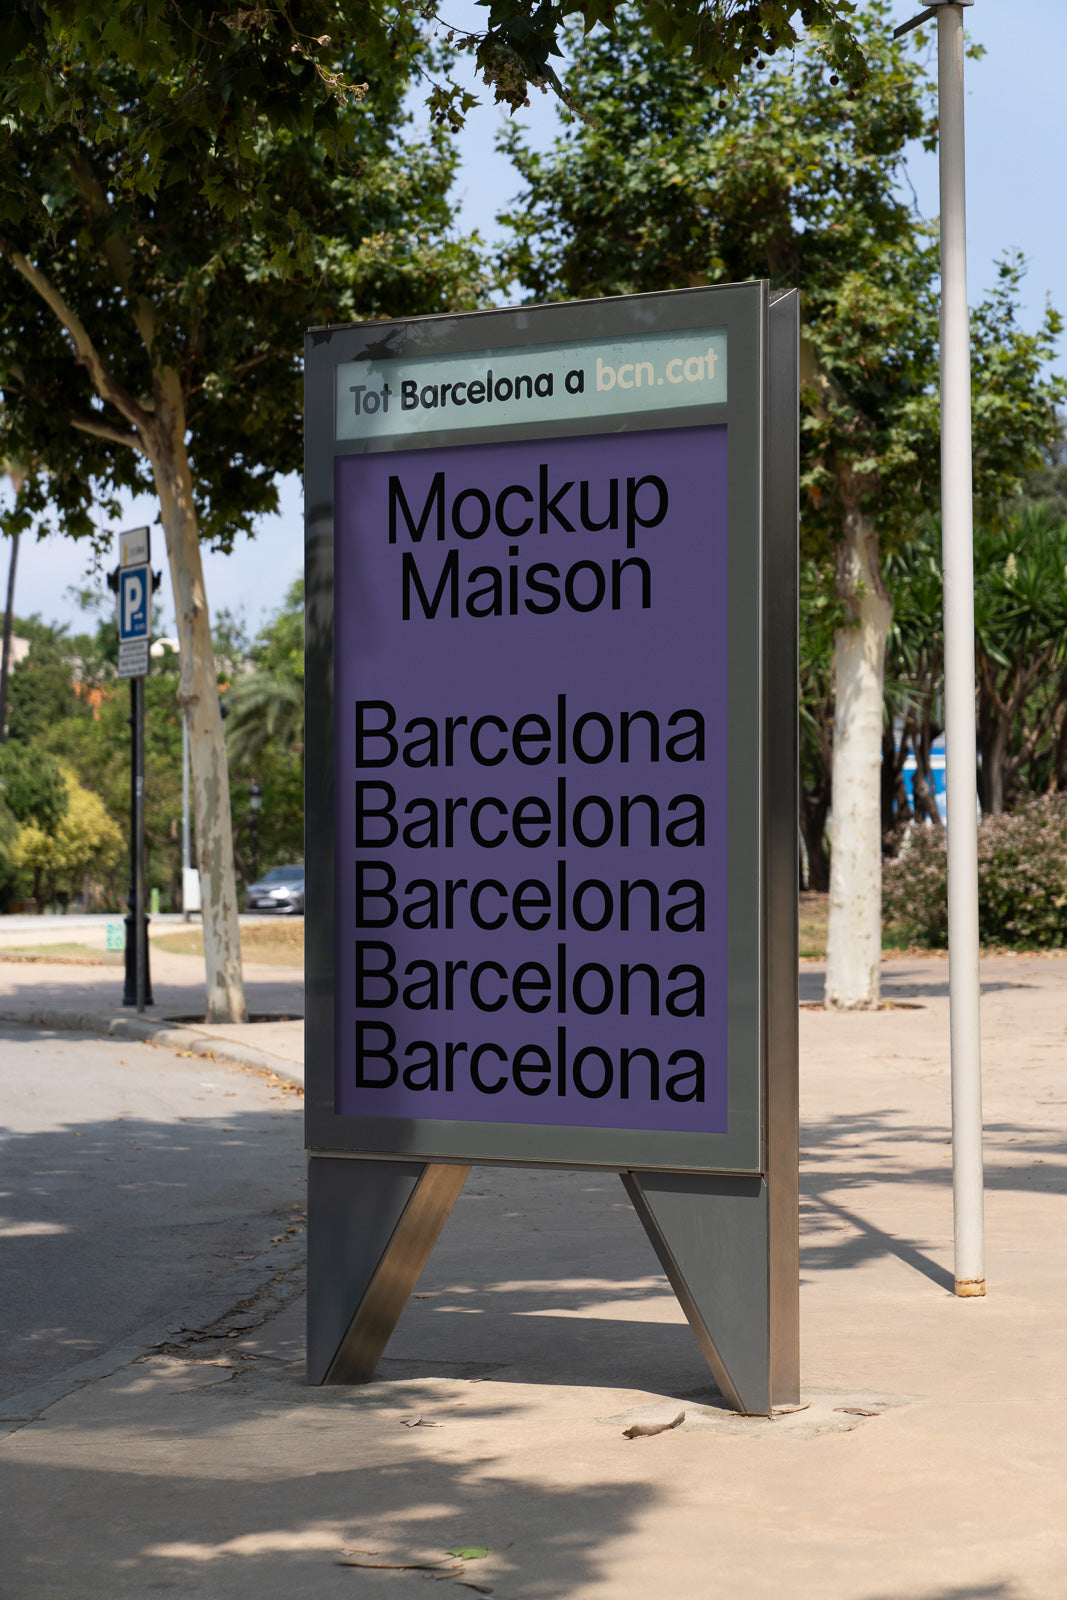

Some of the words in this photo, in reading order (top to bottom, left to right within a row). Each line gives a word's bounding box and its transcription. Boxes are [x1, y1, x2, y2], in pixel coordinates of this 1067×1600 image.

[350, 383, 392, 415] Tot
[401, 369, 554, 411] Barcelona
[564, 369, 585, 394] a
[596, 347, 718, 391] bcn.cat
[388, 464, 669, 549] Mockup
[124, 576, 142, 632] P
[402, 545, 651, 621] Maison
[355, 694, 705, 769] Barcelona
[355, 777, 705, 849] Barcelona
[355, 860, 705, 932] Barcelona
[355, 940, 705, 1018] Barcelona
[355, 1020, 705, 1103] Barcelona
